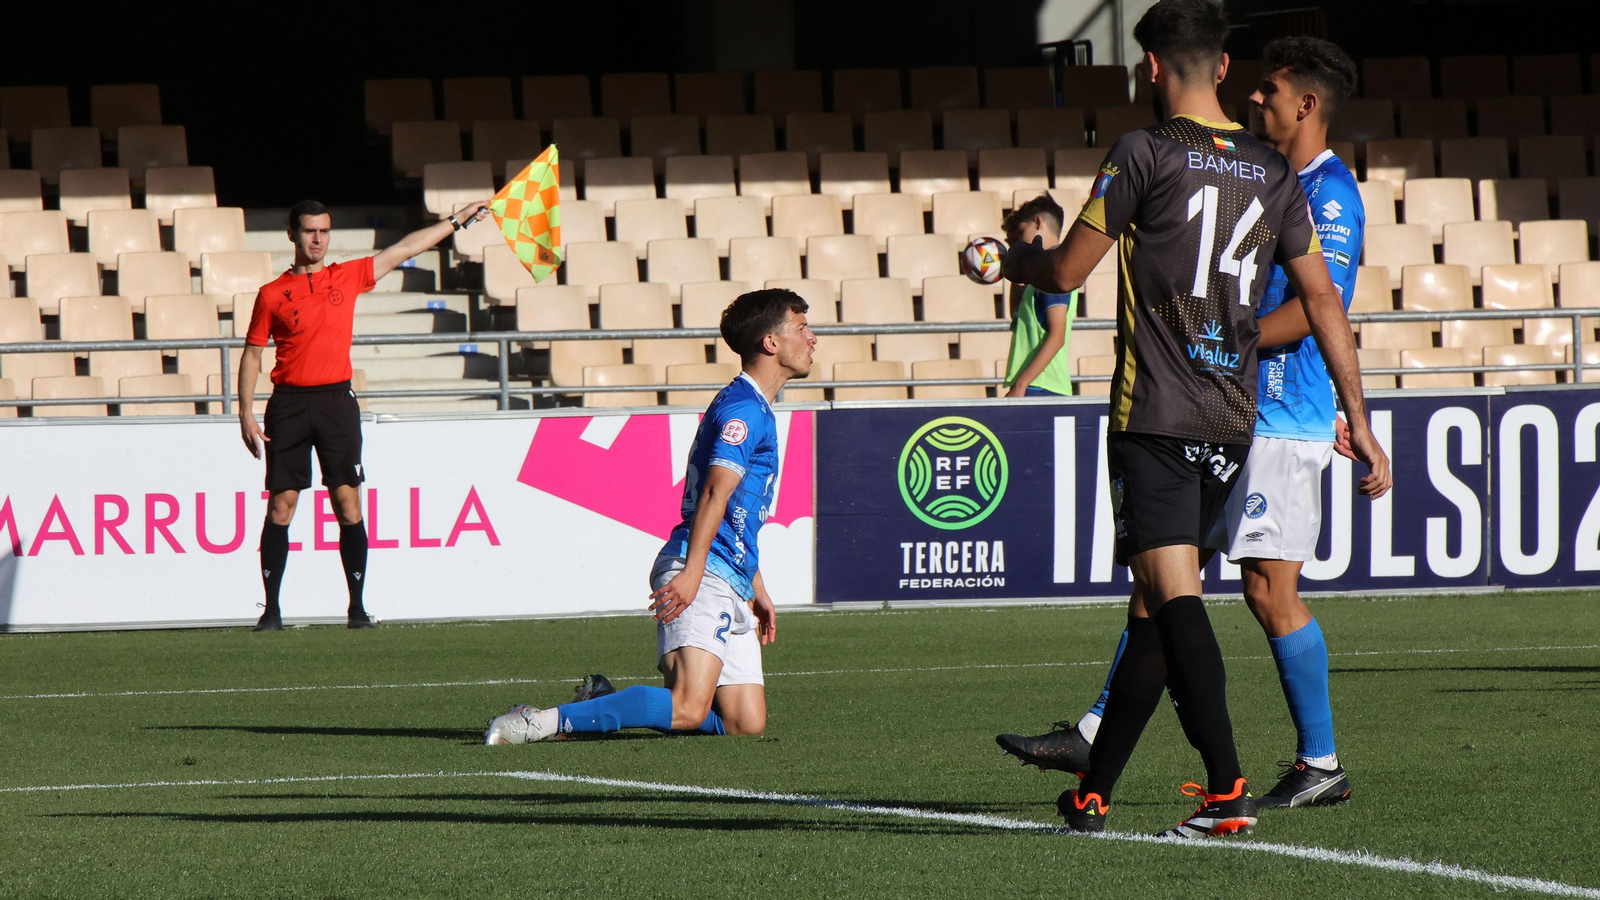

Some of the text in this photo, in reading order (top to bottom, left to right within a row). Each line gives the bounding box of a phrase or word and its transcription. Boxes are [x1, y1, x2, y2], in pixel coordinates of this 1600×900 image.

[1187, 151, 1266, 184] BAMER
[1187, 185, 1265, 306] 14
[1266, 361, 1277, 399] ENERGY
[1274, 362, 1285, 400] GREEN
[936, 456, 971, 471] RF
[936, 475, 971, 490] EF
[900, 540, 1005, 575] TERCERA
[899, 575, 1006, 588] FEDERACIÓN
[713, 612, 732, 647] 2
